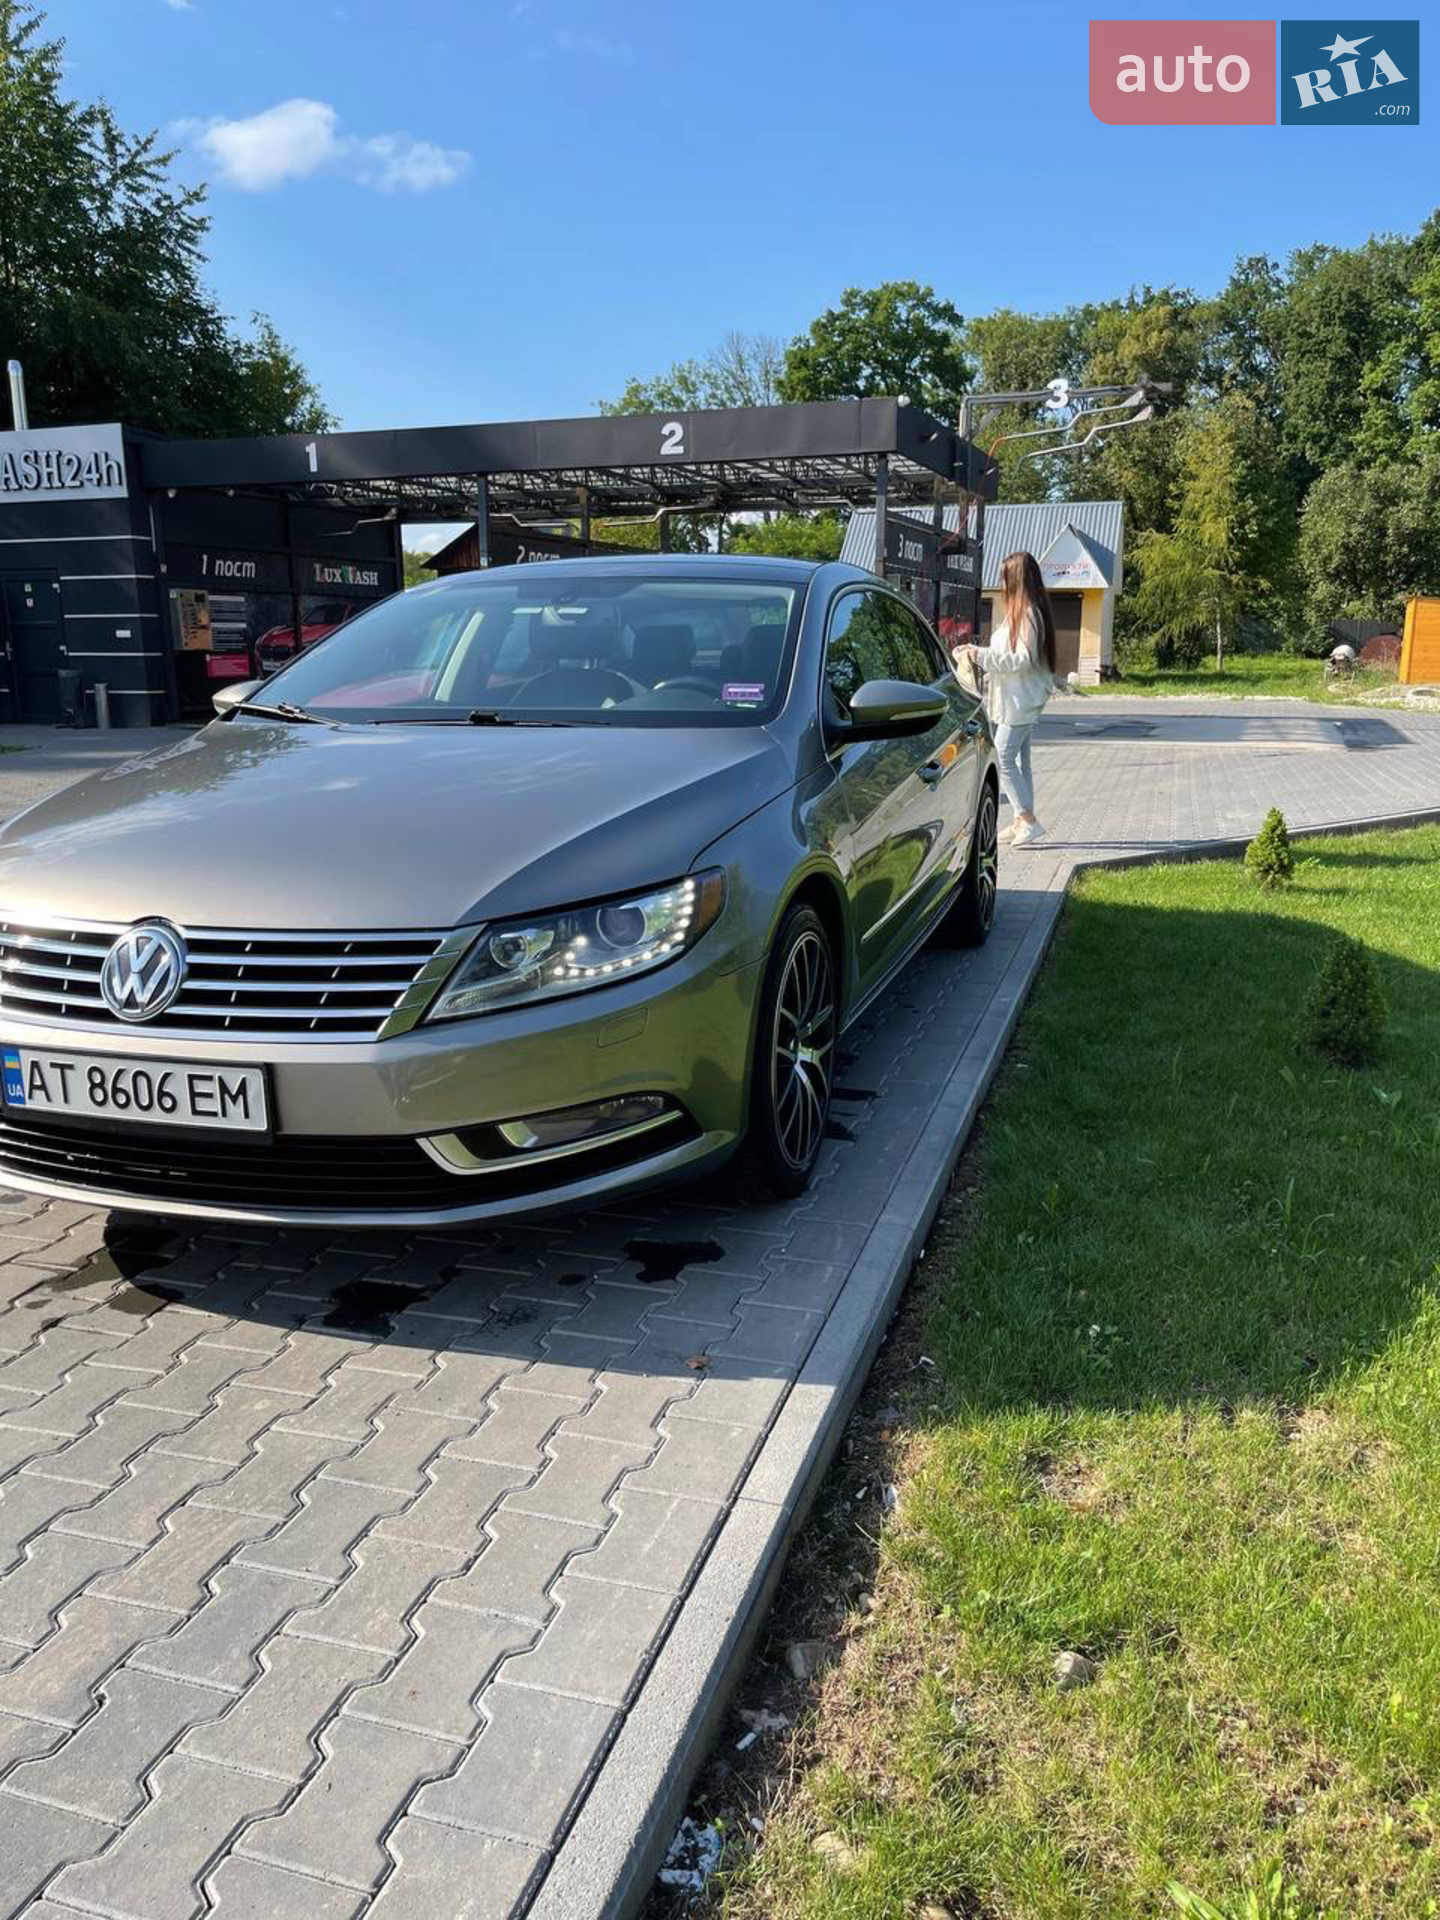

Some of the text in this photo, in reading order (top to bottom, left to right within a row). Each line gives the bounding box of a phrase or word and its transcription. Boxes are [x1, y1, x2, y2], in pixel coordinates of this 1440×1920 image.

[1045, 377, 1069, 408] 3
[660, 421, 684, 455] 2
[305, 442, 318, 473] 1
[202, 554, 208, 575] 1
[7, 1083, 24, 1098] UA
[27, 1059, 250, 1120] AT 8606 EM
